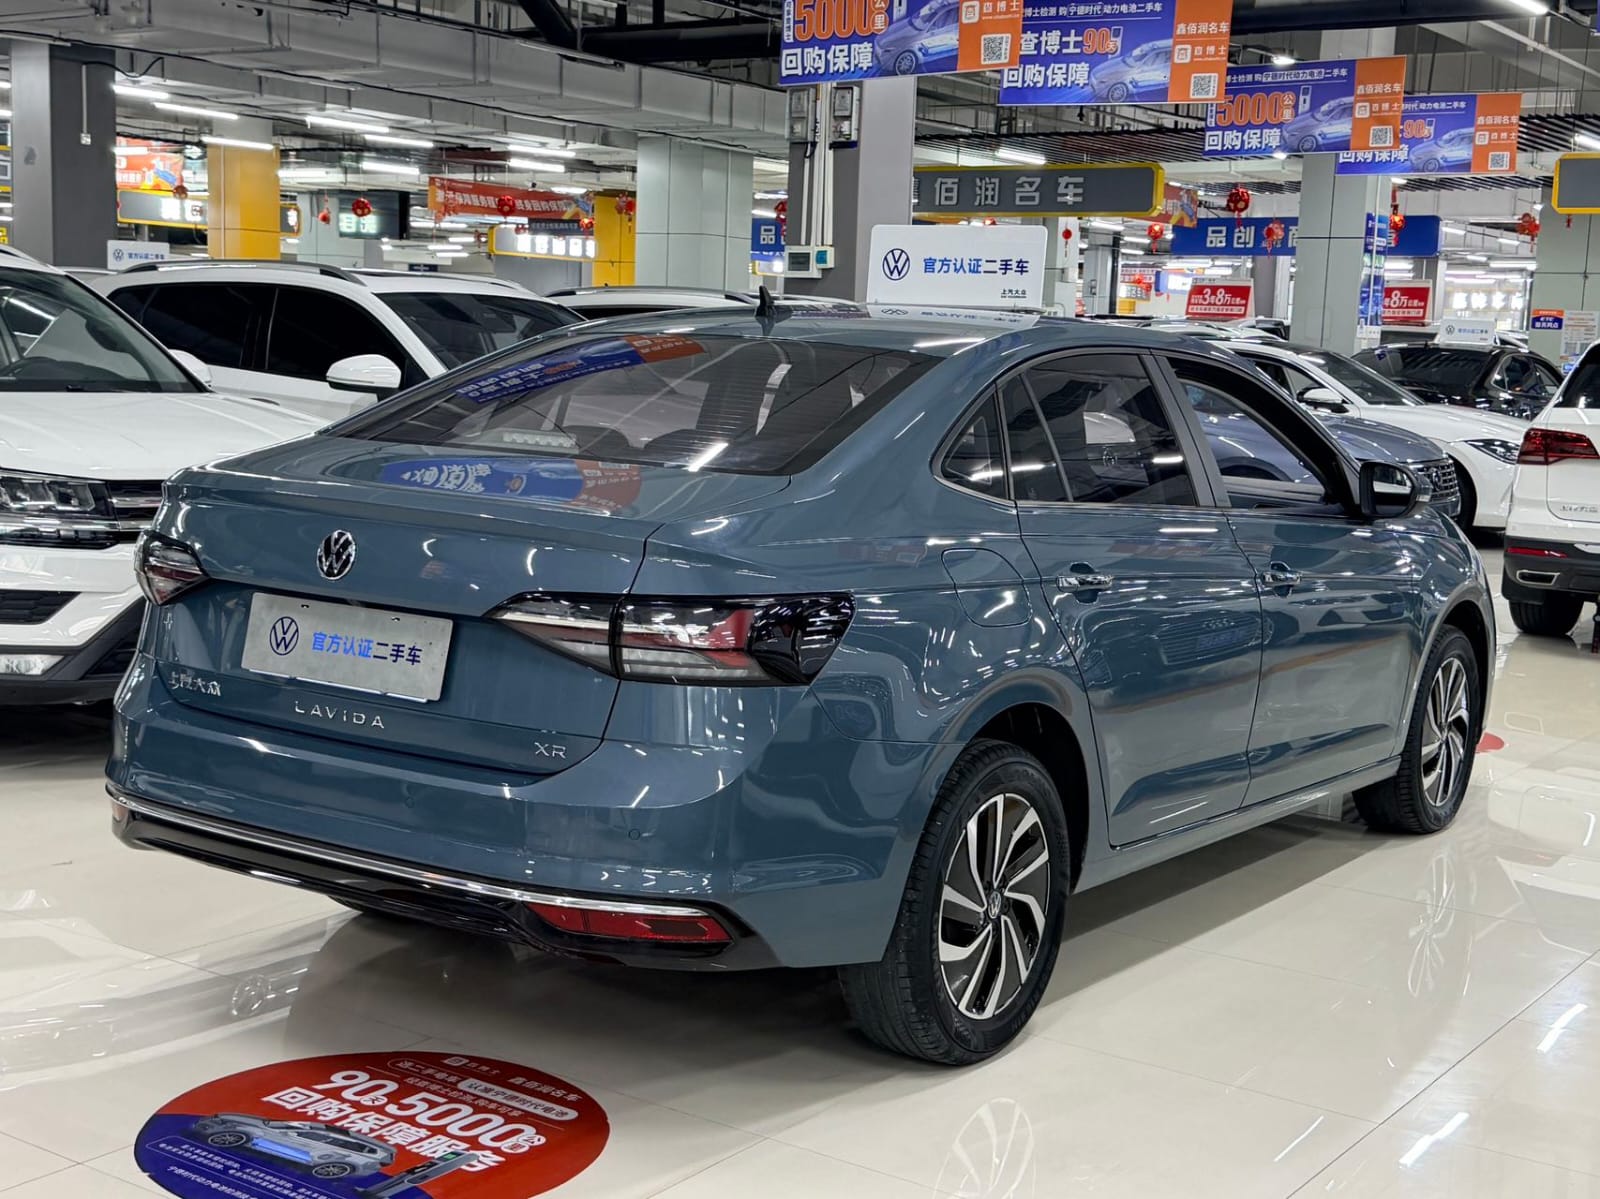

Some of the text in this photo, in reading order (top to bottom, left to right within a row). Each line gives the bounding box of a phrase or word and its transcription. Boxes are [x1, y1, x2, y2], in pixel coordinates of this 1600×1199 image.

[1023, 7, 1056, 17] 博士检测
[781, 42, 873, 77] 回购保障
[1002, 63, 1090, 89] 回购保障
[1205, 128, 1281, 151] 回购保障
[923, 257, 1030, 276] 官方认证二手车
[312, 632, 422, 665] 官方认证二手车
[295, 701, 386, 729] LAVIDA
[534, 741, 567, 760] XR
